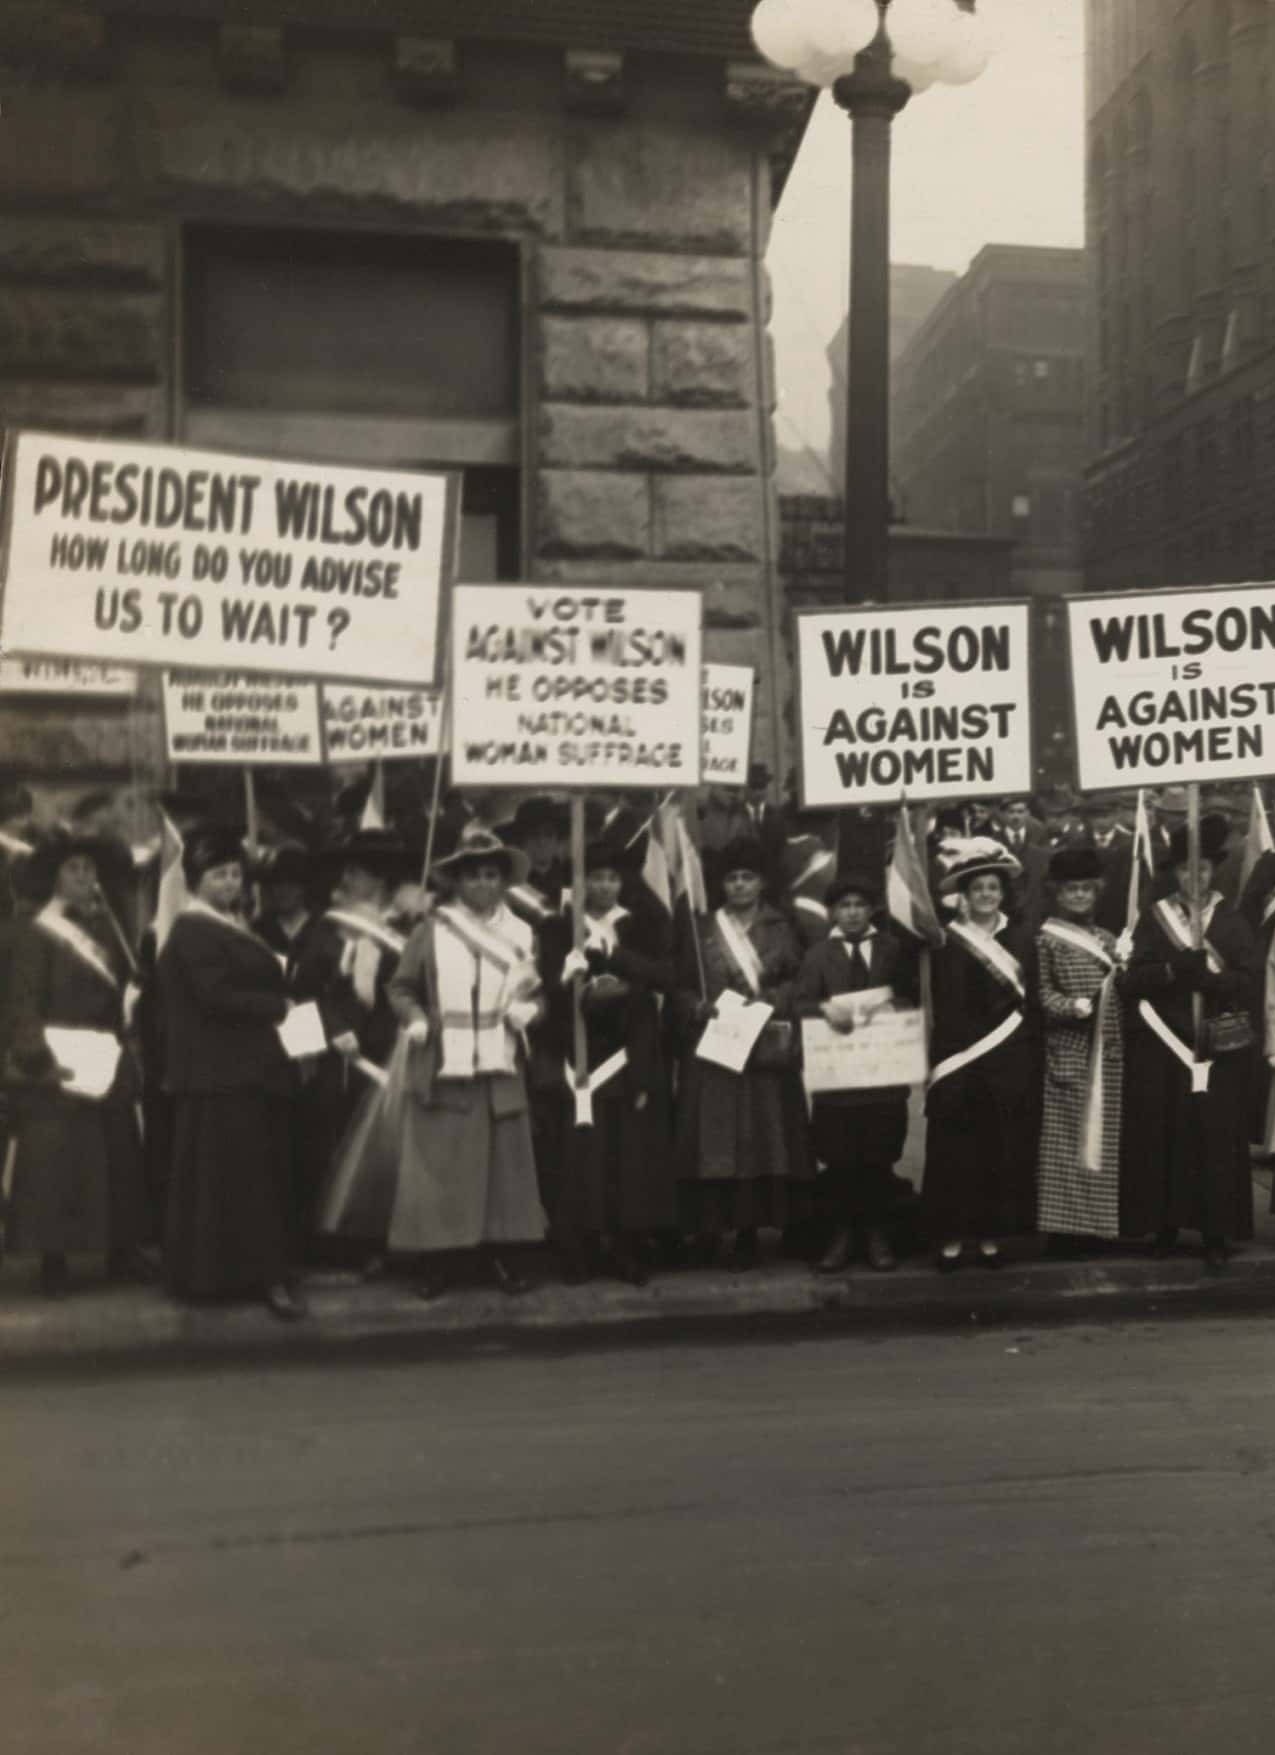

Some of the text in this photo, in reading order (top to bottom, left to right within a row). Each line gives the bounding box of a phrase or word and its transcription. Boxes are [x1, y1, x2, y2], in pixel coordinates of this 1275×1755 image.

[34, 455, 422, 550] PRESIDENT WILSON
[50, 533, 400, 599] HOW LONG DO YOU ADVISE
[95, 588, 142, 632] US
[158, 593, 203, 639] TO
[528, 597, 625, 623] VOTE
[466, 625, 580, 664] AGAINST
[821, 625, 1010, 677] WILSON
[485, 673, 520, 701] HE
[532, 675, 668, 704] OPPOSES
[901, 680, 936, 700] IS
[1172, 662, 1203, 681] IS
[325, 722, 428, 751] WOMEN
[517, 711, 636, 737] NATIONAL
[823, 703, 1017, 746] AGAINST
[466, 740, 547, 765] WOMAN
[558, 740, 682, 768] SUFFRAGE
[1108, 724, 1262, 770] WOMEN
[835, 746, 994, 788] WOMEN
